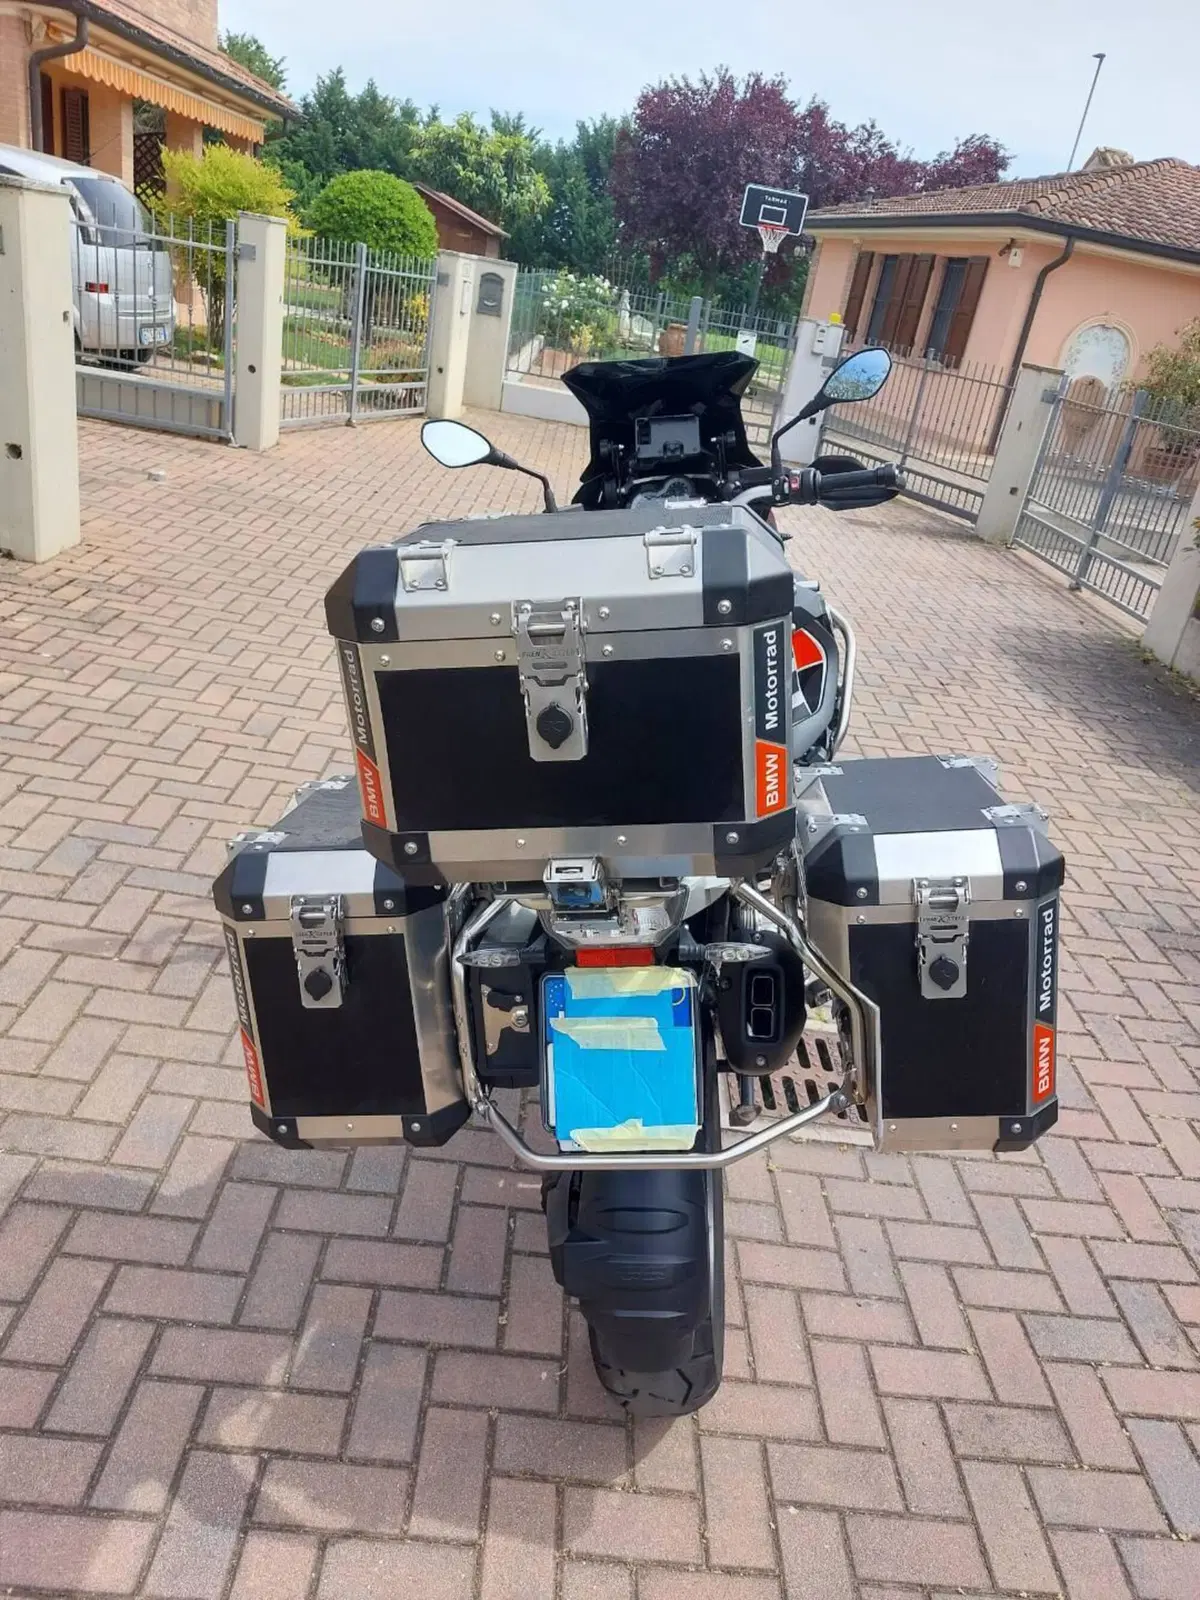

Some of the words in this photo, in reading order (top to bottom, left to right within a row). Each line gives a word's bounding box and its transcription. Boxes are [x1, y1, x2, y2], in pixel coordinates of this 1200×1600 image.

[343, 650, 368, 745] Motorrad
[763, 629, 779, 731] Motorrad
[363, 767, 380, 818] BMW
[766, 753, 779, 807] BMW
[226, 932, 249, 1026] Motorrad
[1039, 907, 1055, 1013] Motorrad
[243, 1044, 261, 1098] BMW
[1038, 1037, 1051, 1094] BMW
